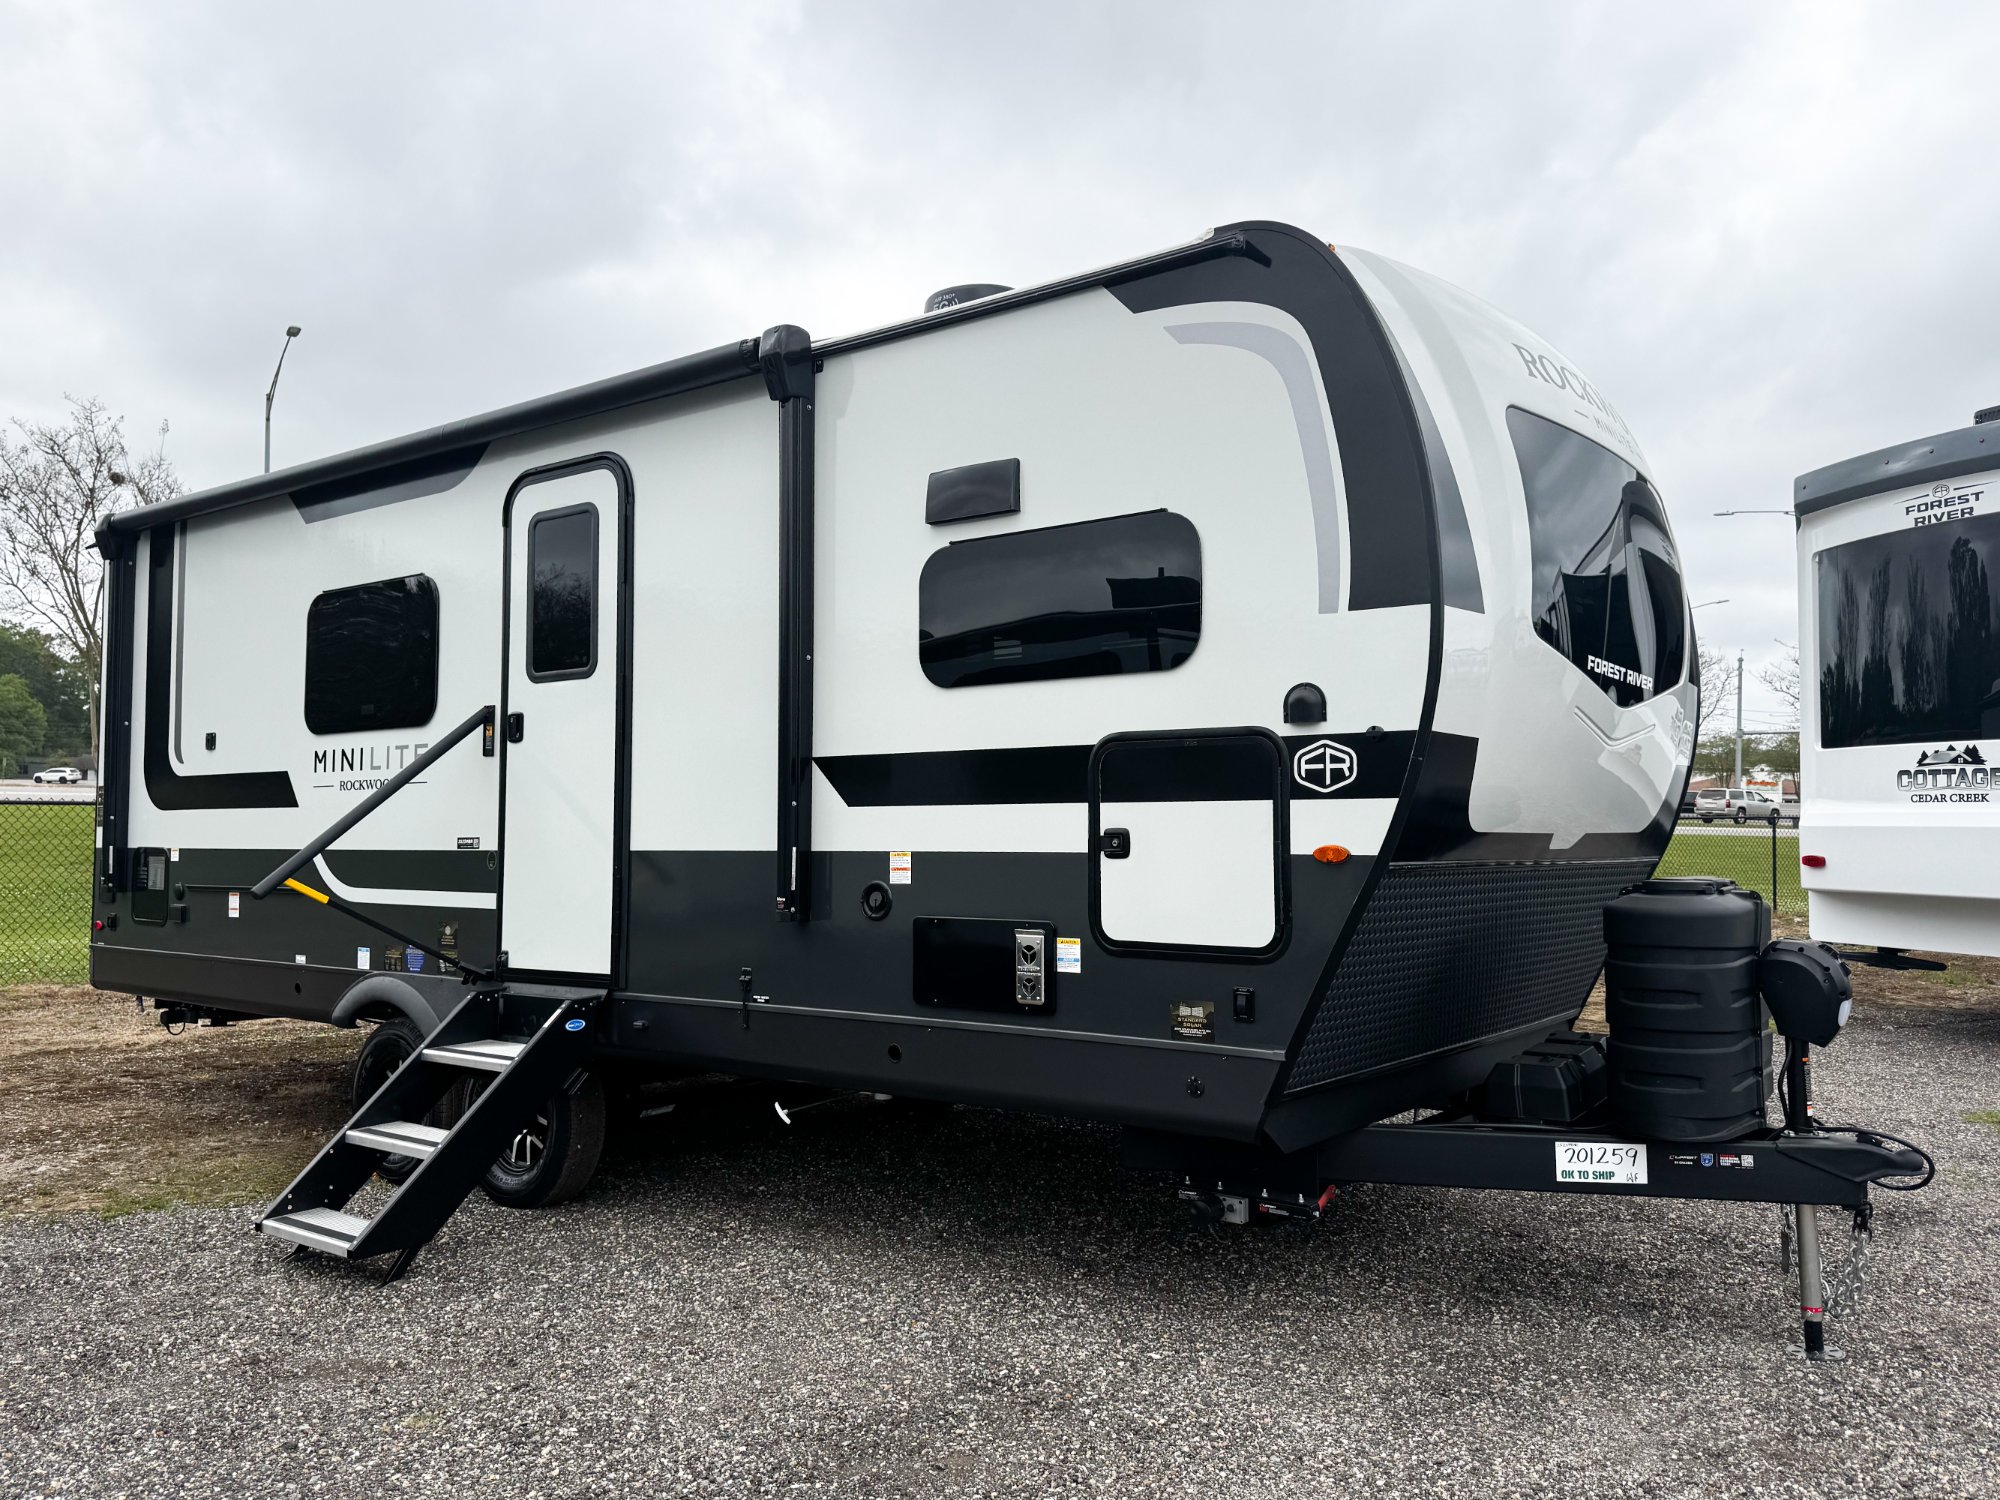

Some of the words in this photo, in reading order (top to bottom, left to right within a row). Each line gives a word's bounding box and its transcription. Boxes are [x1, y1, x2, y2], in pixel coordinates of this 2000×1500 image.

[1905, 491, 1984, 516] FOREST
[1914, 506, 1974, 527] RIVER
[1587, 654, 1626, 682] FOREST
[1626, 669, 1654, 692] RIVER
[1897, 767, 2000, 792] COTTAGE
[1910, 793, 1948, 803] CEDAR
[1949, 793, 1990, 803] CREEK
[1564, 1147, 1638, 1168] 201259
[1561, 1170, 1575, 1180] OK
[1577, 1170, 1589, 1180] TO
[1592, 1170, 1615, 1181] SHIP
